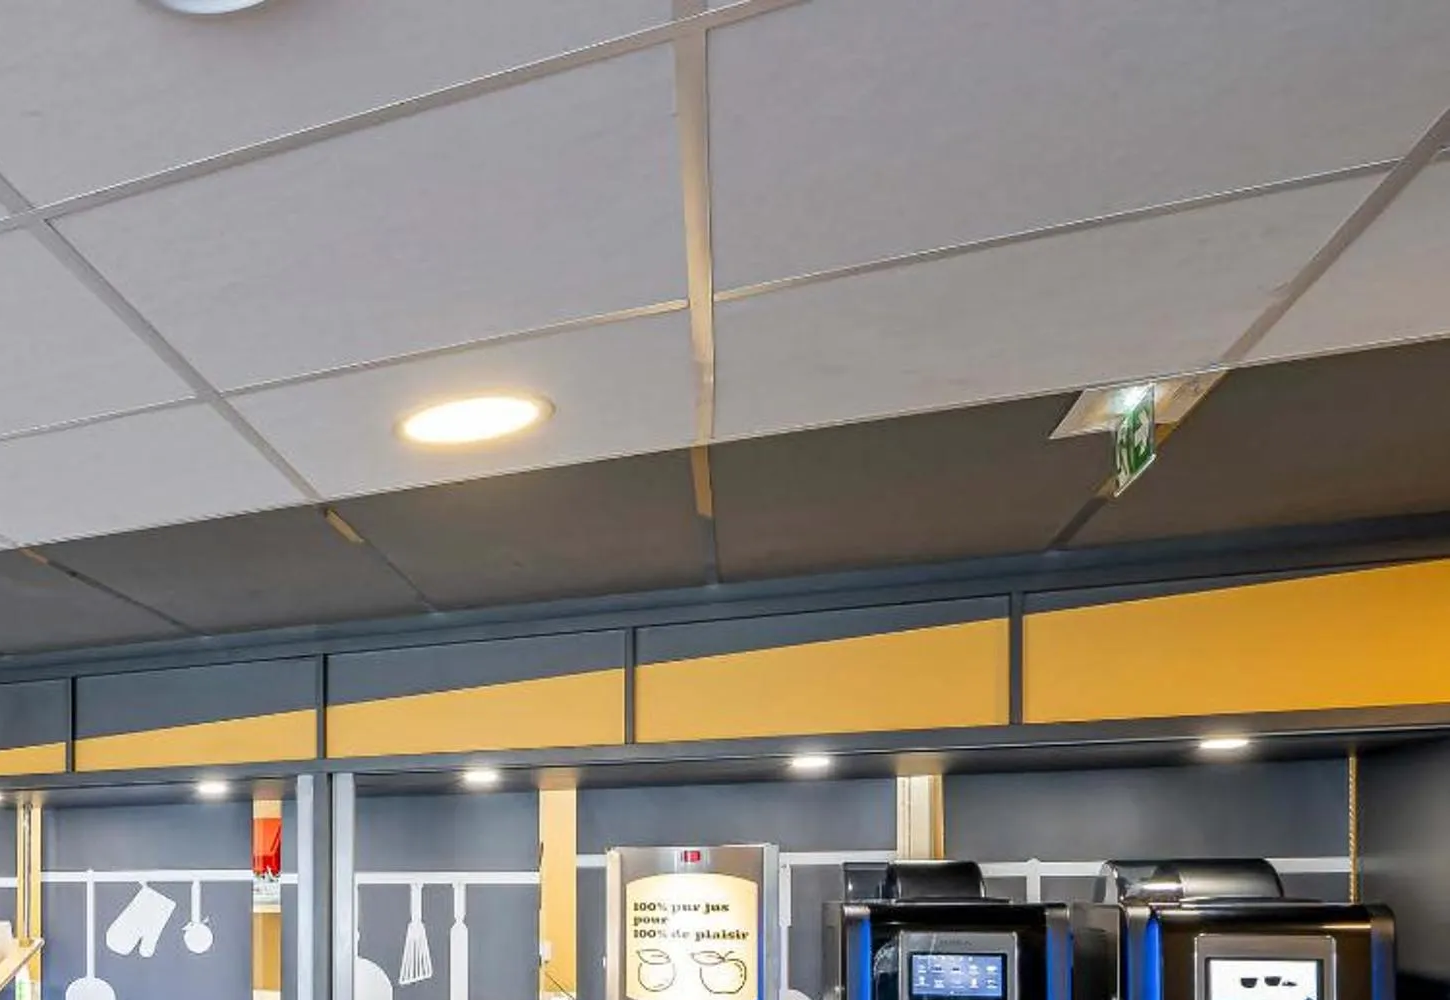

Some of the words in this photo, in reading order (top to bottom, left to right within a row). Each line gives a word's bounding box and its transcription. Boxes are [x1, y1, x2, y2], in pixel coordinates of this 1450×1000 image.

[633, 902, 667, 912] 100%
[671, 903, 701, 914] pur
[704, 902, 730, 914] jus
[633, 915, 669, 926] pour
[633, 929, 667, 939] 100%
[671, 929, 690, 939] de
[695, 929, 749, 942] plaisir
